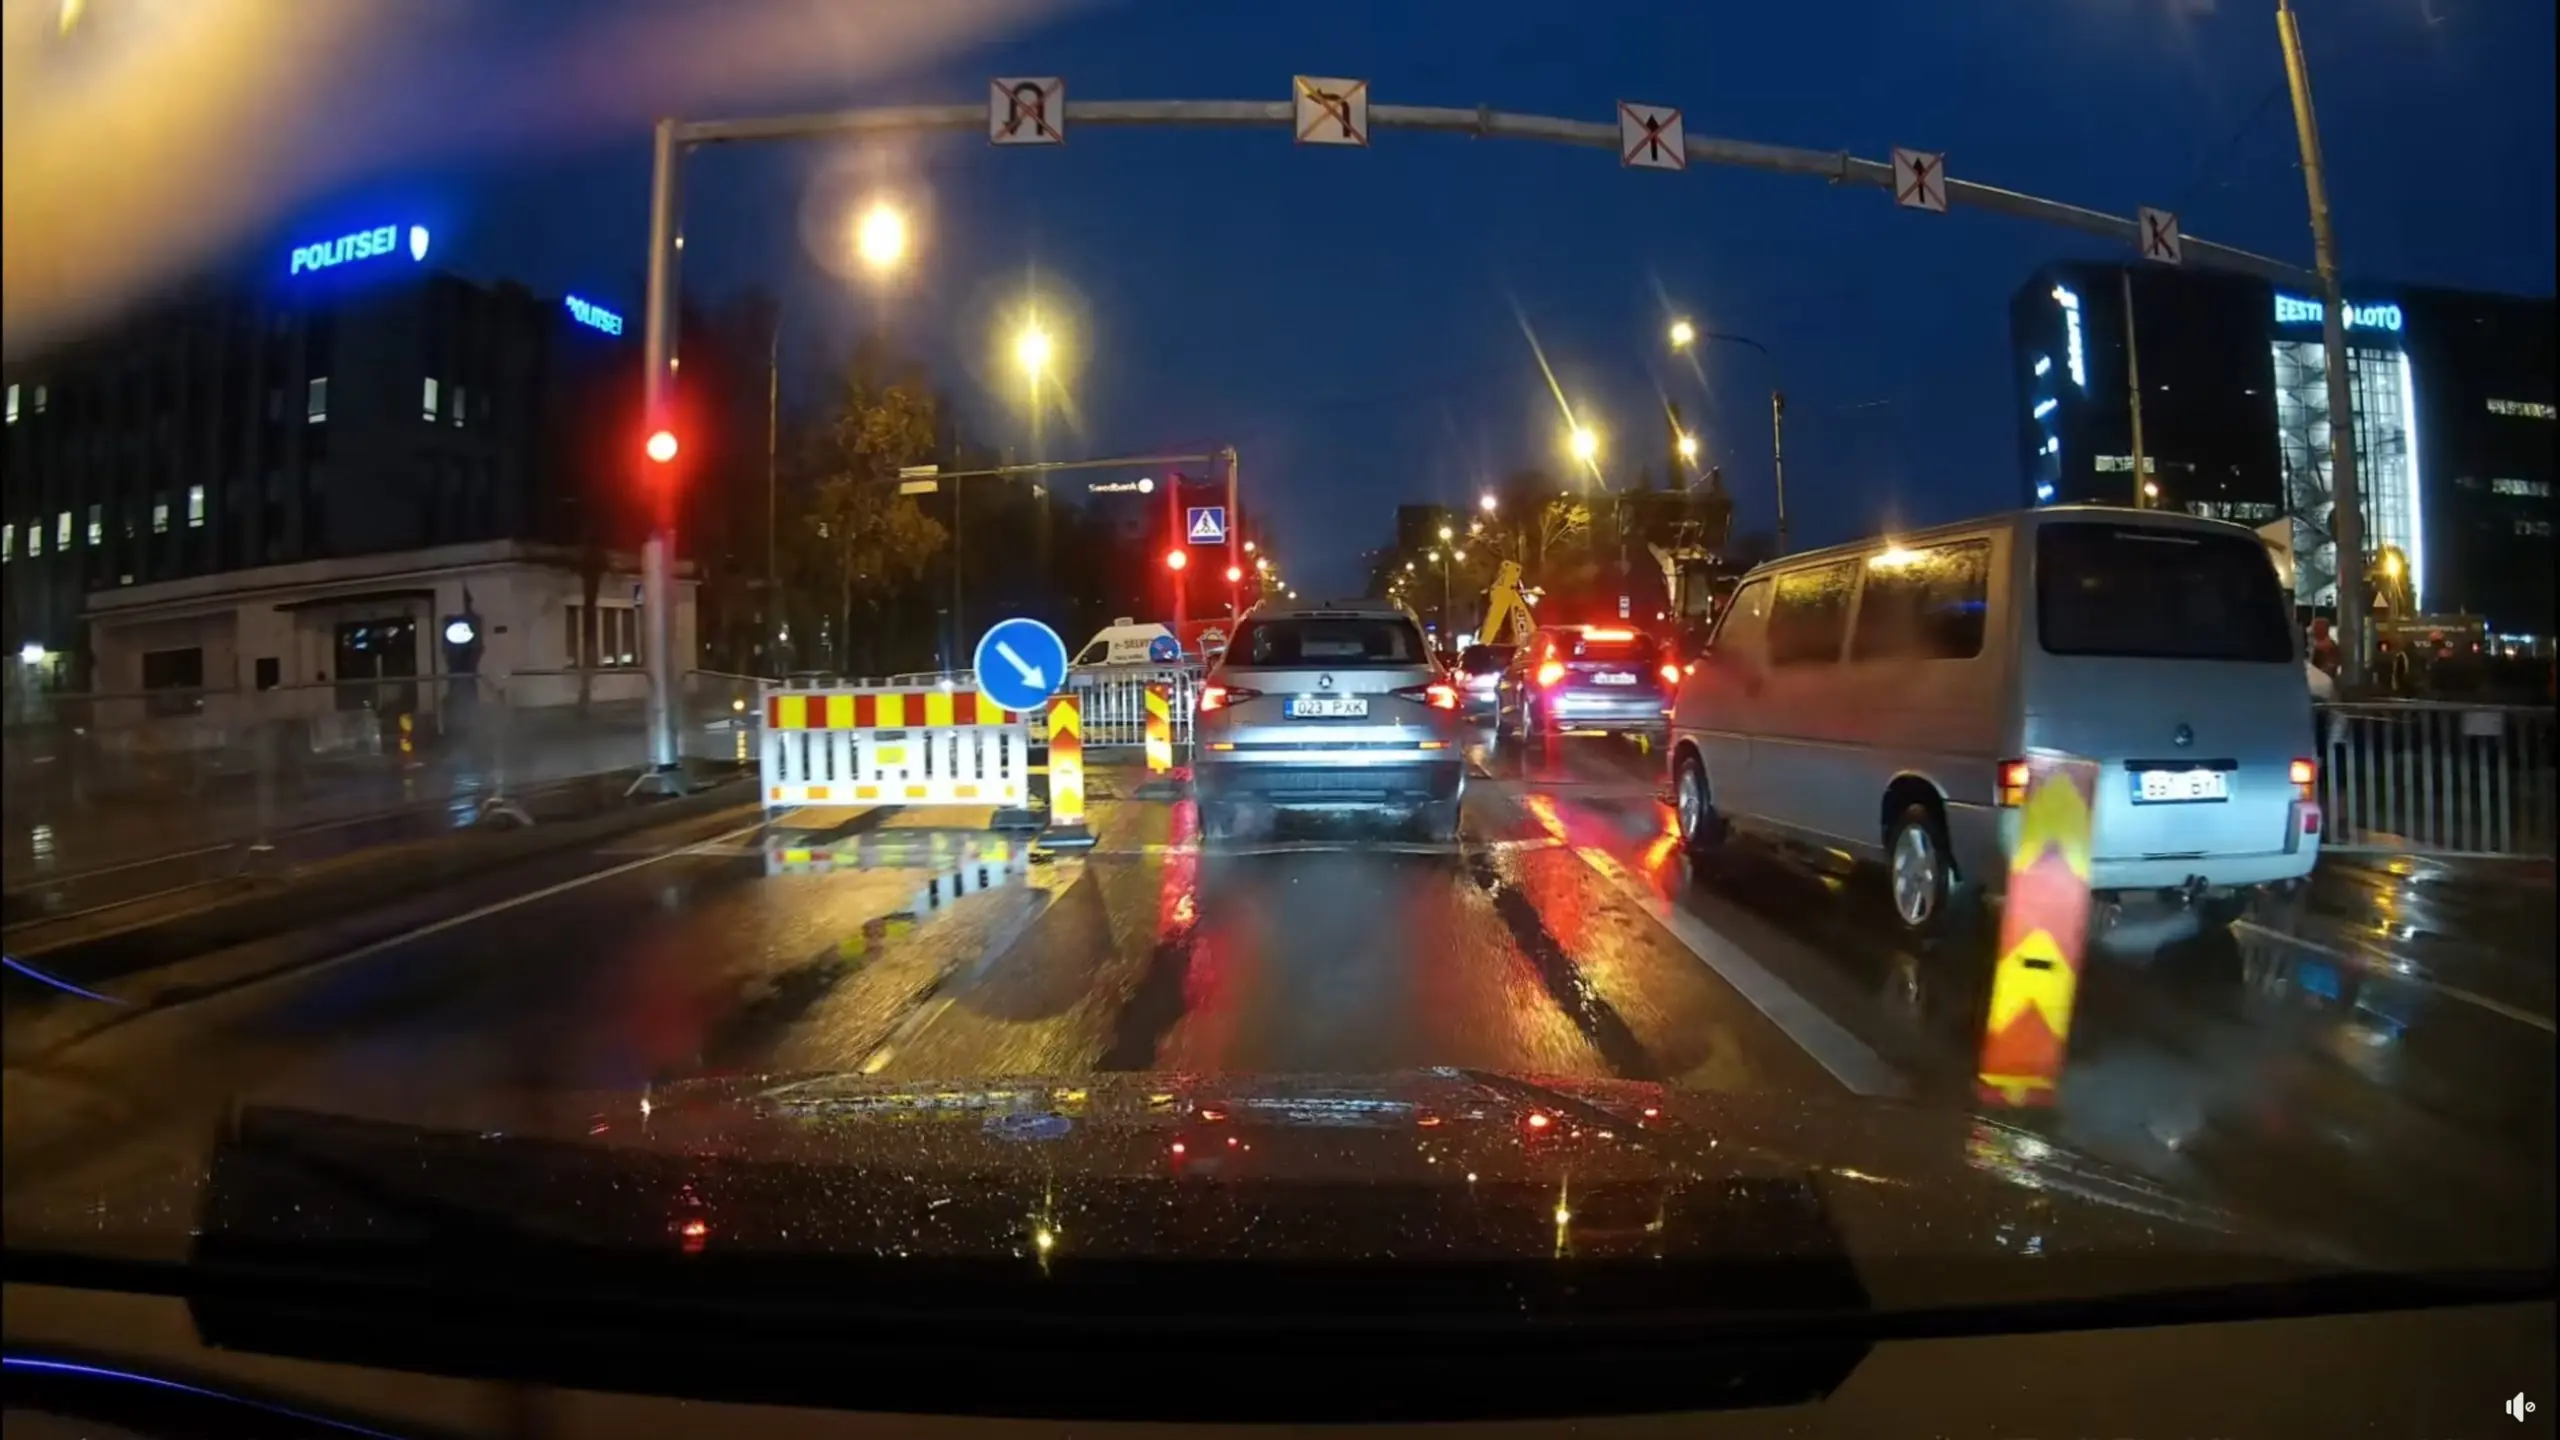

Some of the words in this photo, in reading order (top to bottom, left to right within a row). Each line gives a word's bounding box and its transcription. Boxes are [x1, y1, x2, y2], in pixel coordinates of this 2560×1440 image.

[290, 223, 397, 276] POLITSEI
[566, 295, 623, 335] POLITSEI
[2275, 293, 2323, 322] EESTI
[2354, 304, 2402, 331] LOTO
[1088, 482, 1137, 493] Swedbank
[1298, 701, 1323, 715] 023
[1332, 701, 1363, 715] PXK
